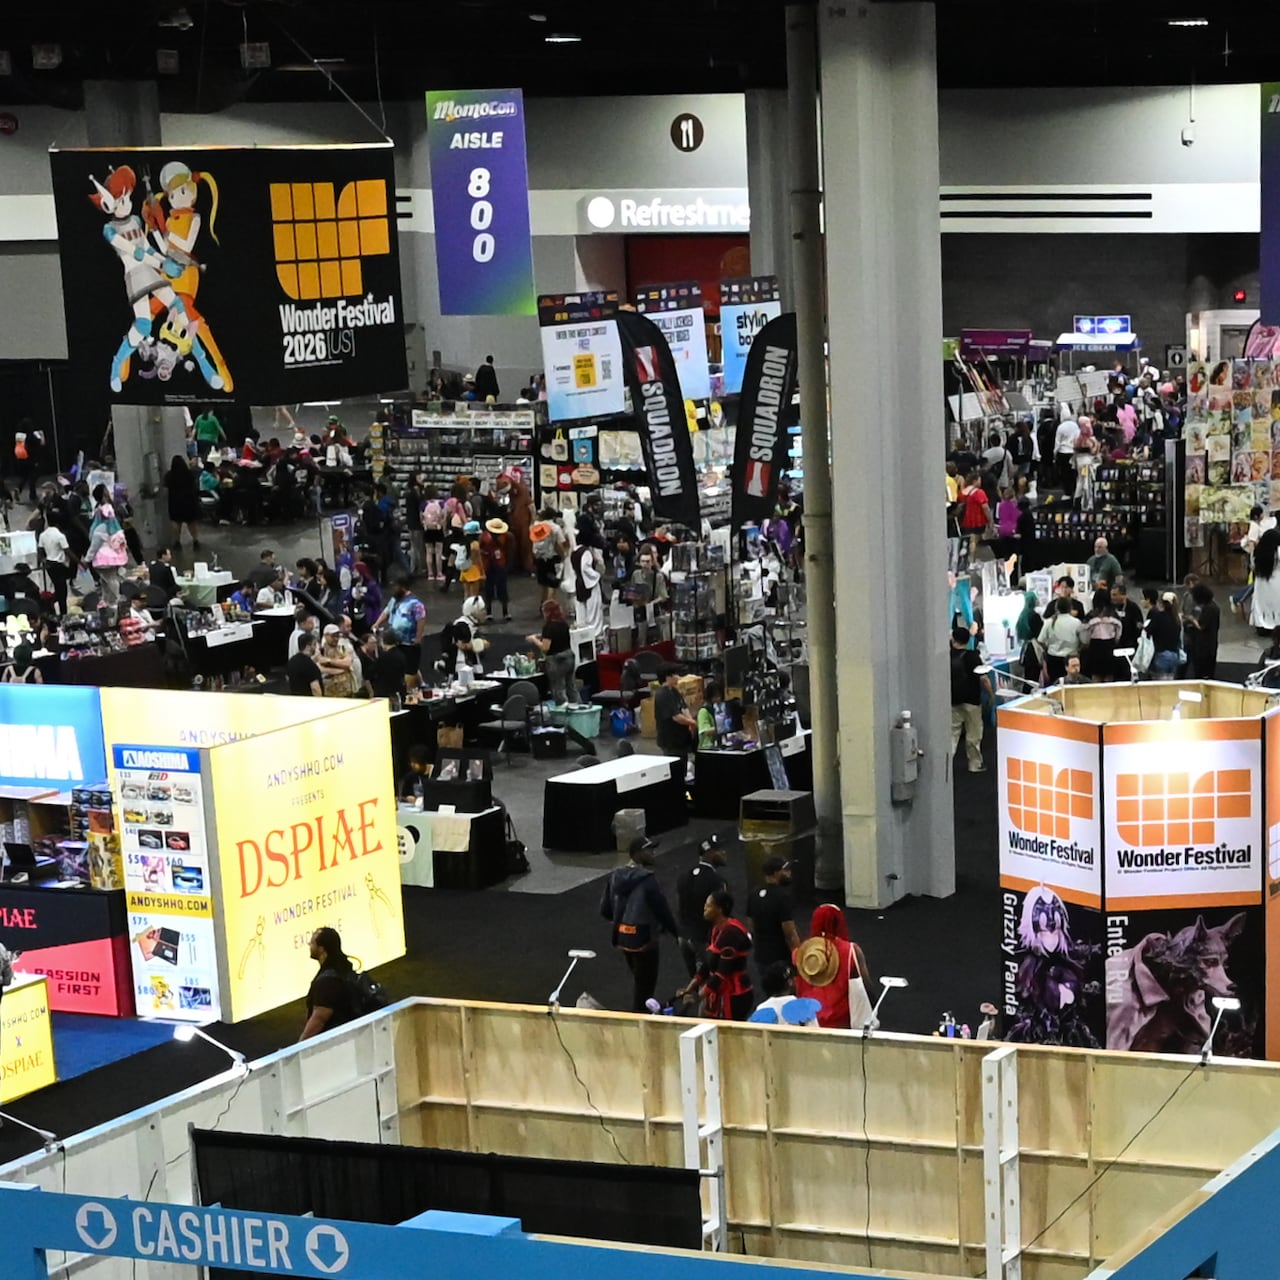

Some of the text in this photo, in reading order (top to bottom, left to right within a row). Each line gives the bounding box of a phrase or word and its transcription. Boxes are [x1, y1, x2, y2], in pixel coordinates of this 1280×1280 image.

[433, 100, 516, 120] MomoCon
[450, 132, 503, 149] AISLE
[467, 167, 495, 263] 800
[279, 292, 395, 333] Wonder Festival
[283, 332, 327, 363] 2026
[750, 345, 789, 462] SQUADRON
[641, 382, 683, 496] SQUADRON
[236, 798, 383, 899] DSPIAE
[1008, 830, 1049, 856] Wonder
[1050, 840, 1094, 865] Festival
[1117, 849, 1182, 868] Wonder
[1184, 842, 1251, 865] Festival
[130, 896, 208, 911] ANDYSHHQ.COM
[273, 885, 357, 926] WONDER FESTIVAL
[1001, 893, 1019, 1016] Grizzly Panda
[58, 984, 101, 996] FIRST
[132, 1207, 293, 1270] CASHIER
